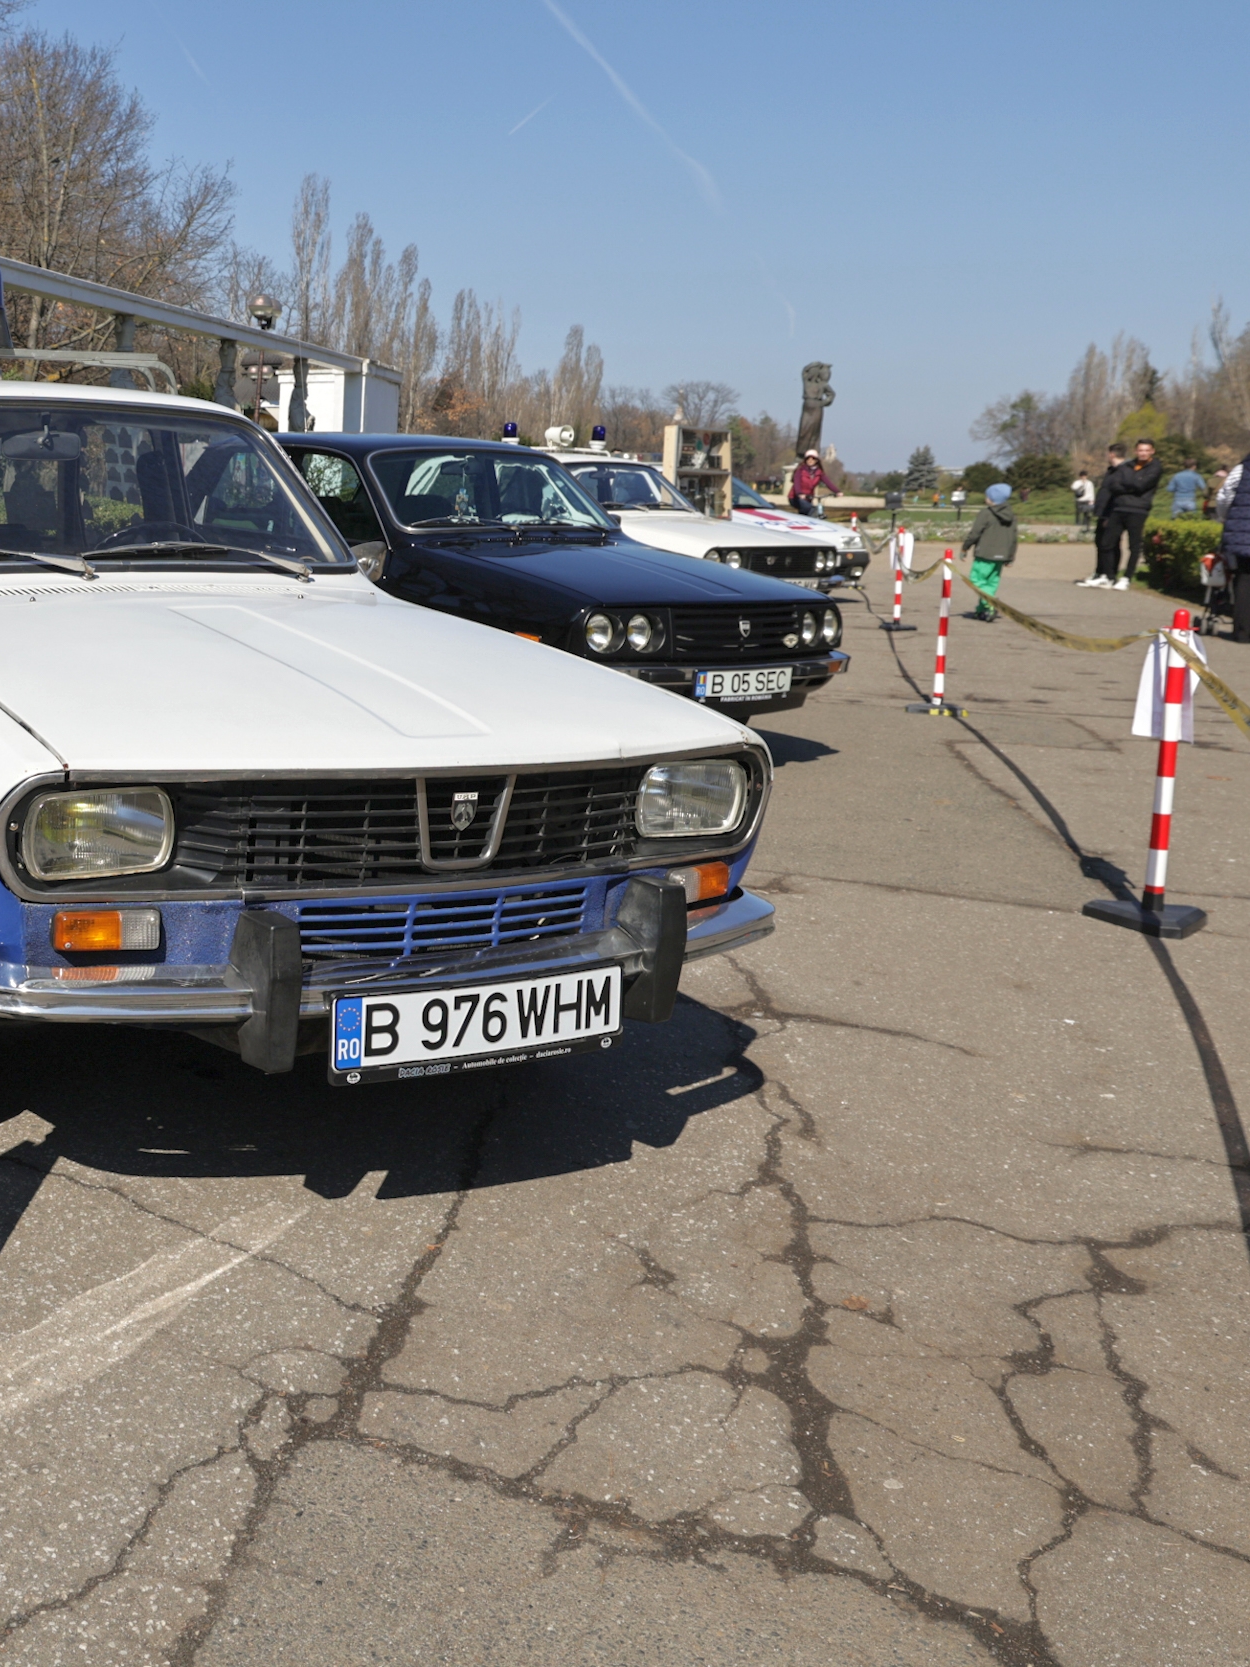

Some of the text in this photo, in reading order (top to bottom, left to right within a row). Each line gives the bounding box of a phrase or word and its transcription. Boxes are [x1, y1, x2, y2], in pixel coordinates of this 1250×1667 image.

[711, 670, 786, 694] B 05 SEC
[364, 976, 612, 1058] B 976 WHM
[338, 1038, 360, 1060] RO
[398, 1066, 424, 1078] DACIA
[426, 1064, 450, 1076] ROSIE
[462, 1058, 496, 1070] Automobile
[506, 1054, 527, 1064] colecție
[536, 1048, 572, 1059] daciarosie.ro
